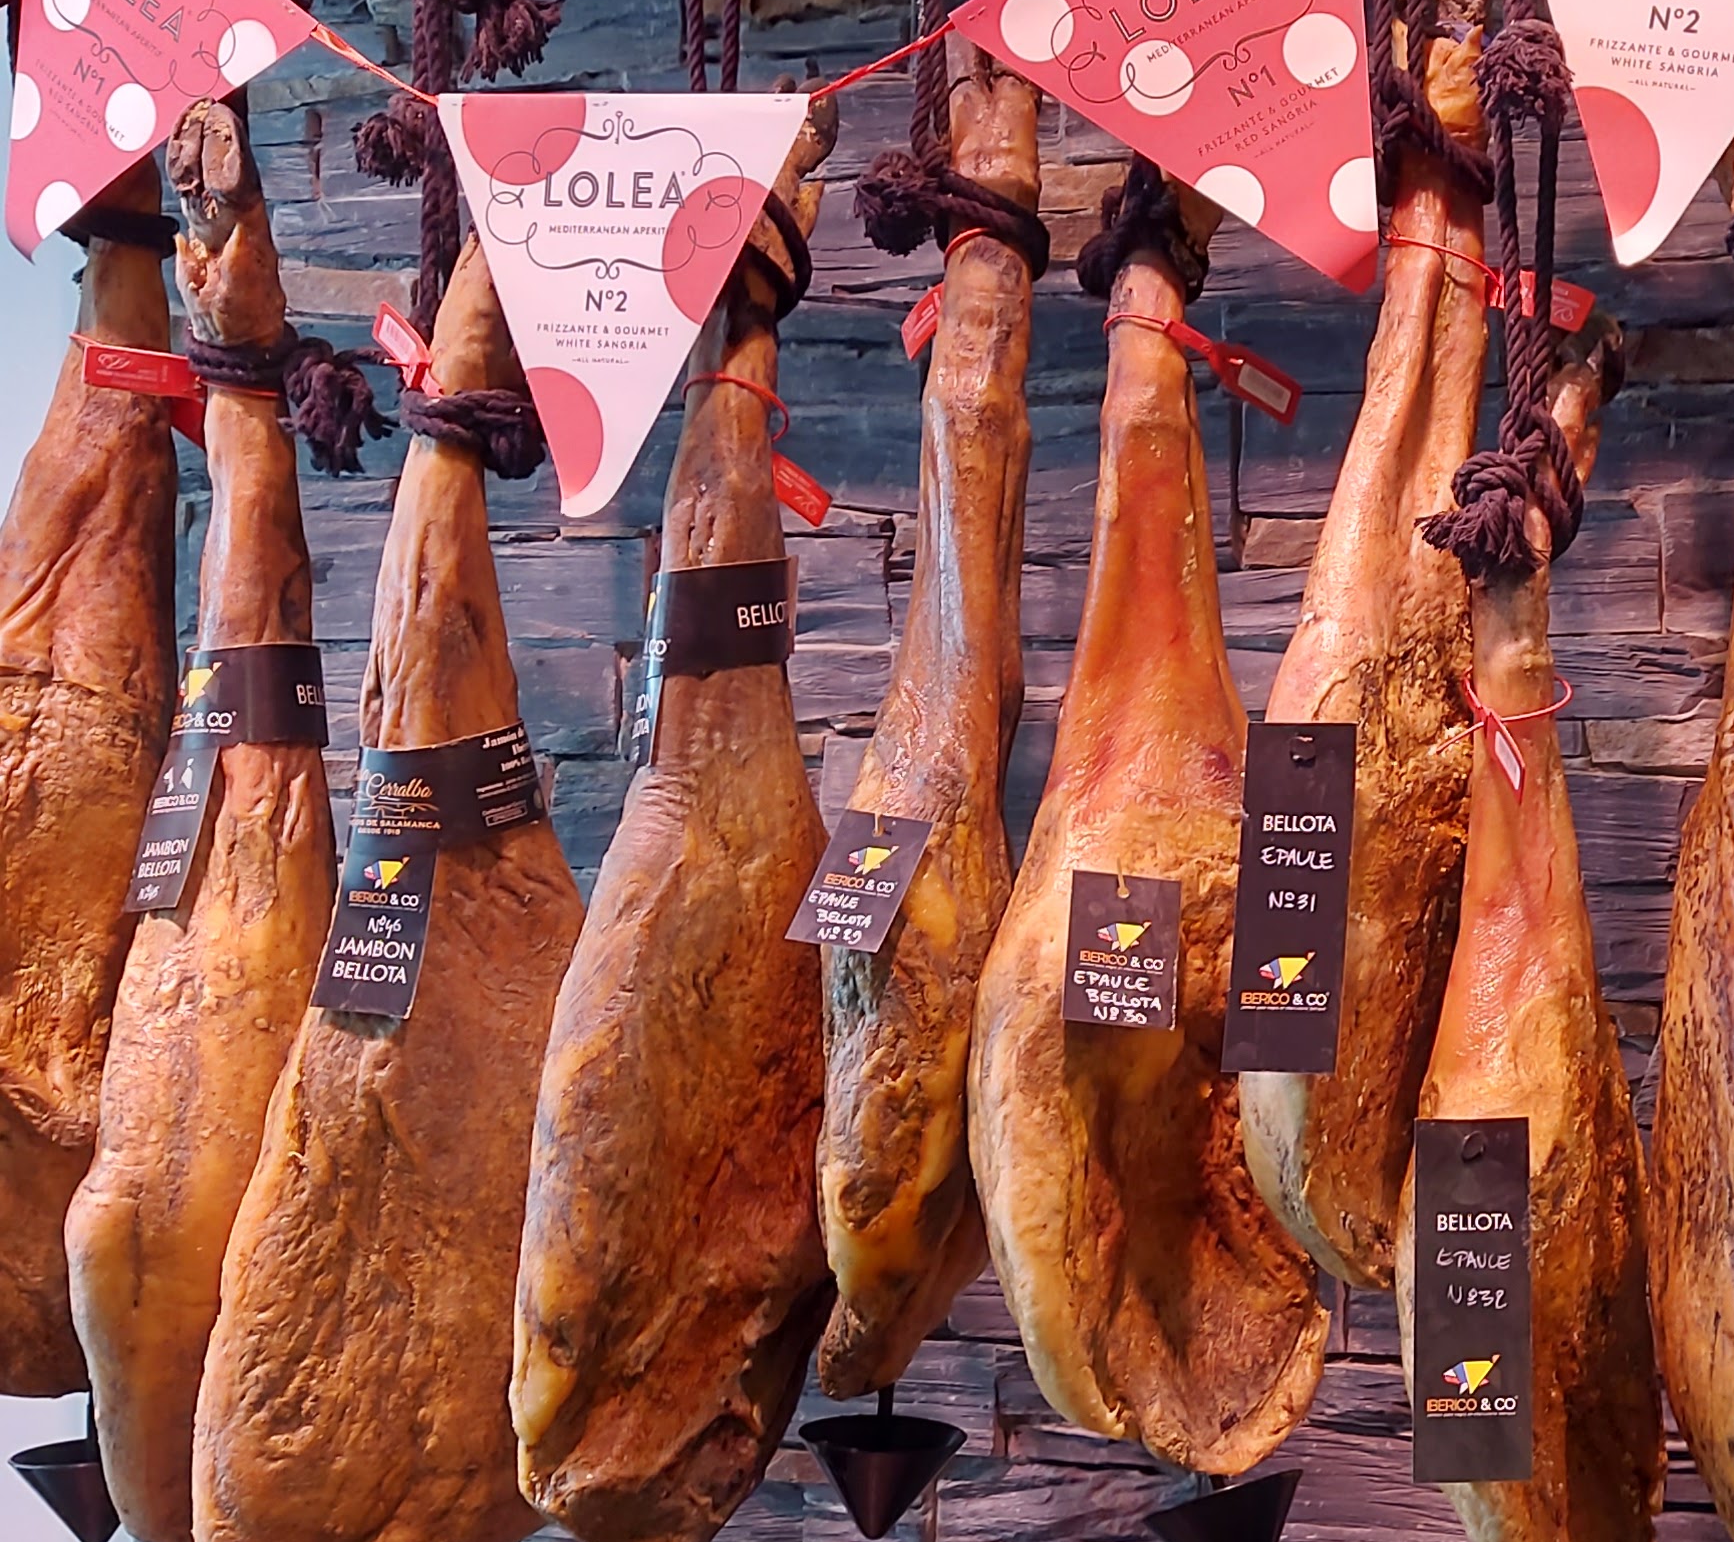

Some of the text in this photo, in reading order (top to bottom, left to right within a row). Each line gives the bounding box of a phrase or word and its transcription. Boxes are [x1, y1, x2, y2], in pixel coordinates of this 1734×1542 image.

[1147, 6, 1234, 62] MEDITERRANEAN
[1590, 38, 1662, 55] FRIZZANTE
[1668, 47, 1675, 56] &
[1611, 57, 1719, 78] WHITE SANGRIA
[1198, 111, 1265, 156] FRIZZANTE
[1280, 67, 1340, 107] GOURMET
[1235, 99, 1317, 151] RED SANGRIA
[544, 171, 685, 208] LOLEA
[549, 225, 629, 234] MEDITERRANEAN
[537, 323, 669, 336] FRIZZANTE & GOURMET
[556, 339, 647, 349] WHITE SANGRIA
[207, 712, 233, 728] CO
[380, 820, 441, 829] SALAMANCA
[1262, 814, 1337, 833] BELLOTA
[142, 838, 189, 858] JAMBON
[1260, 846, 1335, 870] EPAULE
[138, 859, 181, 878] BELLOTA
[865, 879, 874, 891] &
[877, 881, 895, 894] CO
[349, 891, 419, 907] IBERICO & CO
[816, 908, 872, 928] BELLOTA
[335, 936, 415, 960] JAMBON
[1130, 956, 1140, 968] &
[1144, 958, 1164, 970] CO
[332, 961, 407, 985] BELLOTA
[1085, 988, 1162, 1011] BELLOTA
[1240, 992, 1327, 1007] IBERICO & CO
[1437, 1213, 1514, 1231] BELLOTA
[1436, 1247, 1512, 1270] EPAULE
[1426, 1398, 1516, 1412] IBERICO & CO
